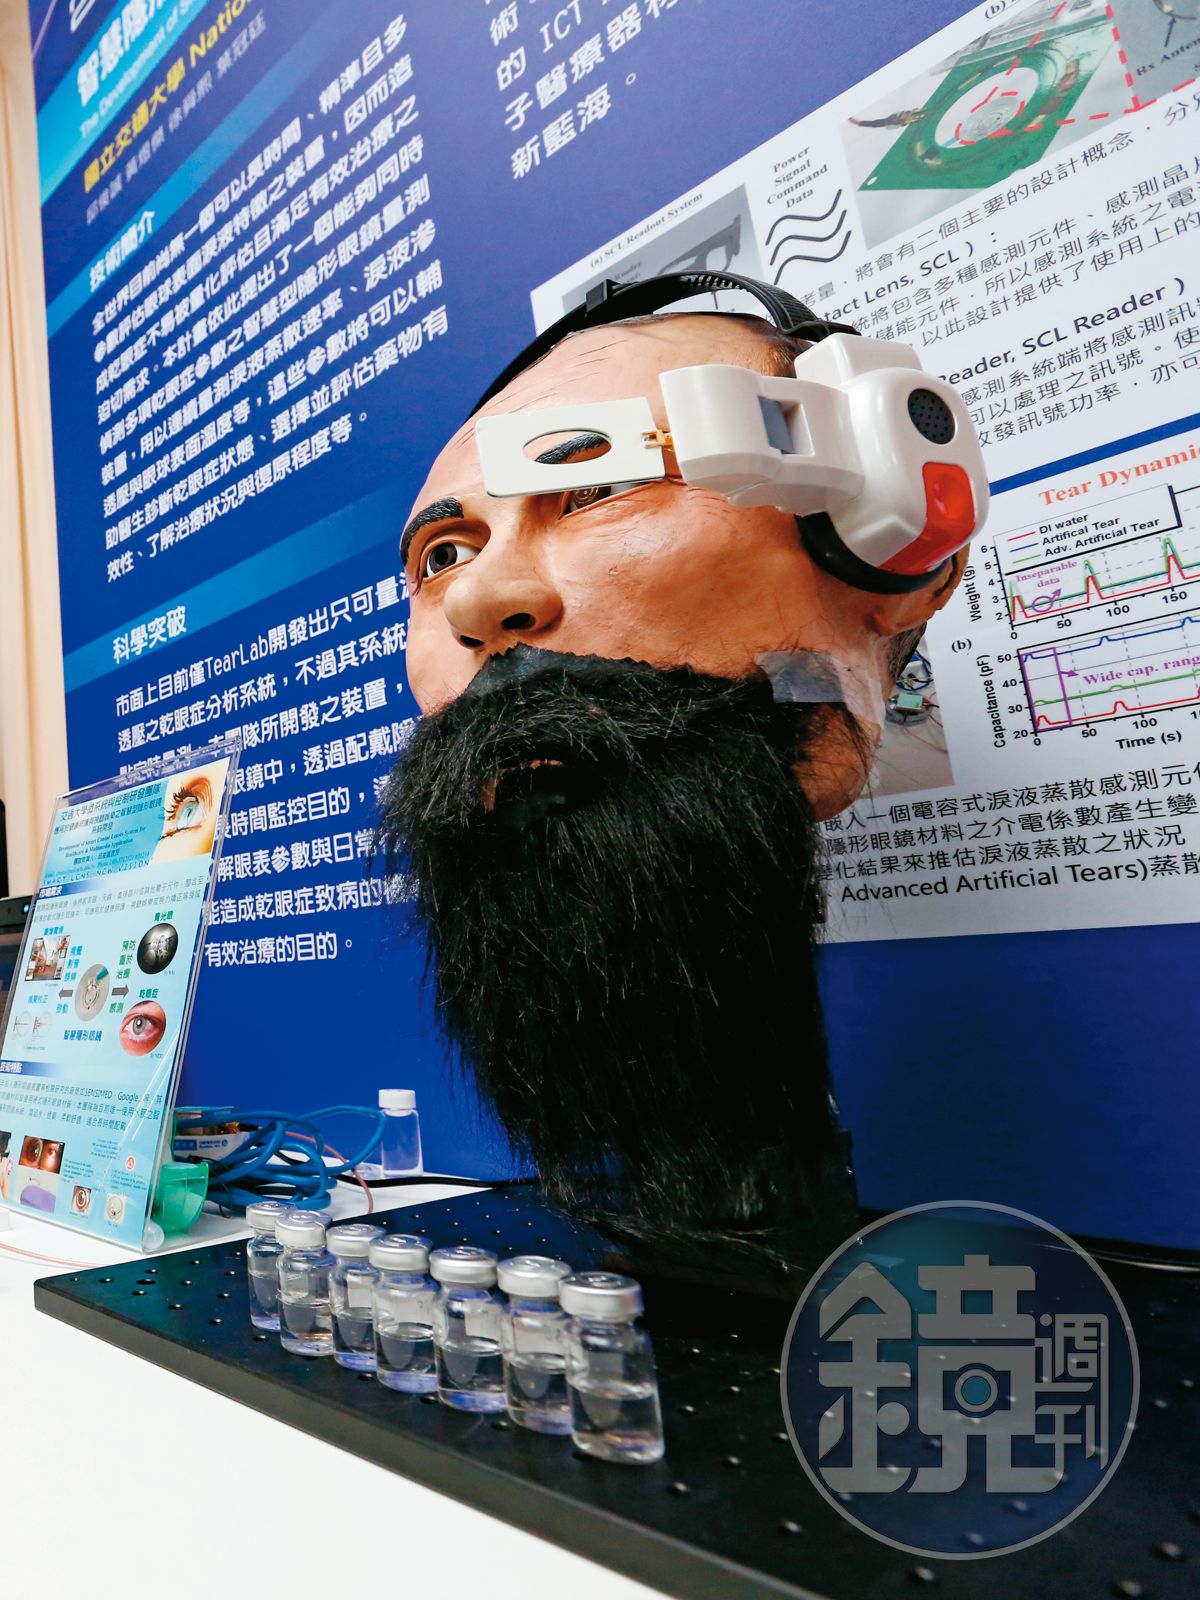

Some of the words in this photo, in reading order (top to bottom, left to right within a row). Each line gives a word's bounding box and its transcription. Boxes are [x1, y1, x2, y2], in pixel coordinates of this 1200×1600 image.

[985, 1, 1006, 20] (b)
[190, 0, 248, 68] Natio
[497, 46, 526, 91] 的
[539, 0, 582, 53] ICT
[77, 0, 166, 107] 智慧隱
[773, 146, 810, 173] Power
[774, 159, 811, 187] Signal
[767, 164, 828, 204] Command
[786, 188, 814, 208] Data
[627, 216, 666, 246] Readout
[667, 193, 703, 221] System
[90, 211, 155, 292] 技術簡介
[864, 275, 914, 303] Lens,
[920, 250, 960, 277] SCL
[961, 297, 1200, 405] 感測系統端將感測訊
[1022, 327, 1068, 356] SCL
[1039, 481, 1091, 505] Tear
[1039, 524, 1052, 535] DI
[1055, 514, 1089, 530] water
[1042, 527, 1089, 546] Artifical
[1092, 517, 1120, 532] Tear
[1044, 544, 1072, 557] Adv.
[1075, 527, 1128, 549] Artificial
[1130, 518, 1160, 534] Tear
[981, 545, 988, 553] 6
[985, 562, 992, 570] 5
[1016, 560, 1078, 583] Inseparable
[988, 579, 995, 587] 4
[1037, 576, 1061, 589] data
[965, 584, 982, 622] Weight
[992, 596, 999, 604] 3
[996, 612, 1003, 620] 2
[1010, 632, 1018, 640] 0
[1056, 619, 1072, 629] 50
[1106, 604, 1130, 617] 100
[1162, 591, 1188, 604] 150
[112, 605, 187, 664] 科學突破
[951, 639, 972, 653] (b)
[976, 654, 994, 677] (pF)
[997, 653, 1012, 663] 50
[118, 619, 410, 753] 透壓之乾眼症分析系統，不過其系統
[1002, 679, 1017, 688] 40
[1083, 668, 1124, 685] Wide
[1127, 664, 1159, 679] cap.
[982, 680, 1006, 748] Capacitance
[1008, 704, 1023, 713] 30
[1013, 729, 1029, 739] 20
[1033, 738, 1041, 746] 0
[1081, 728, 1097, 738] 50
[1132, 717, 1158, 730] 100
[1115, 733, 1156, 750] Time
[1161, 730, 1182, 744] (s)
[841, 876, 949, 902] Advanced
[956, 865, 1059, 893] Artificial
[205, 931, 352, 968] 有效治療的目的。
